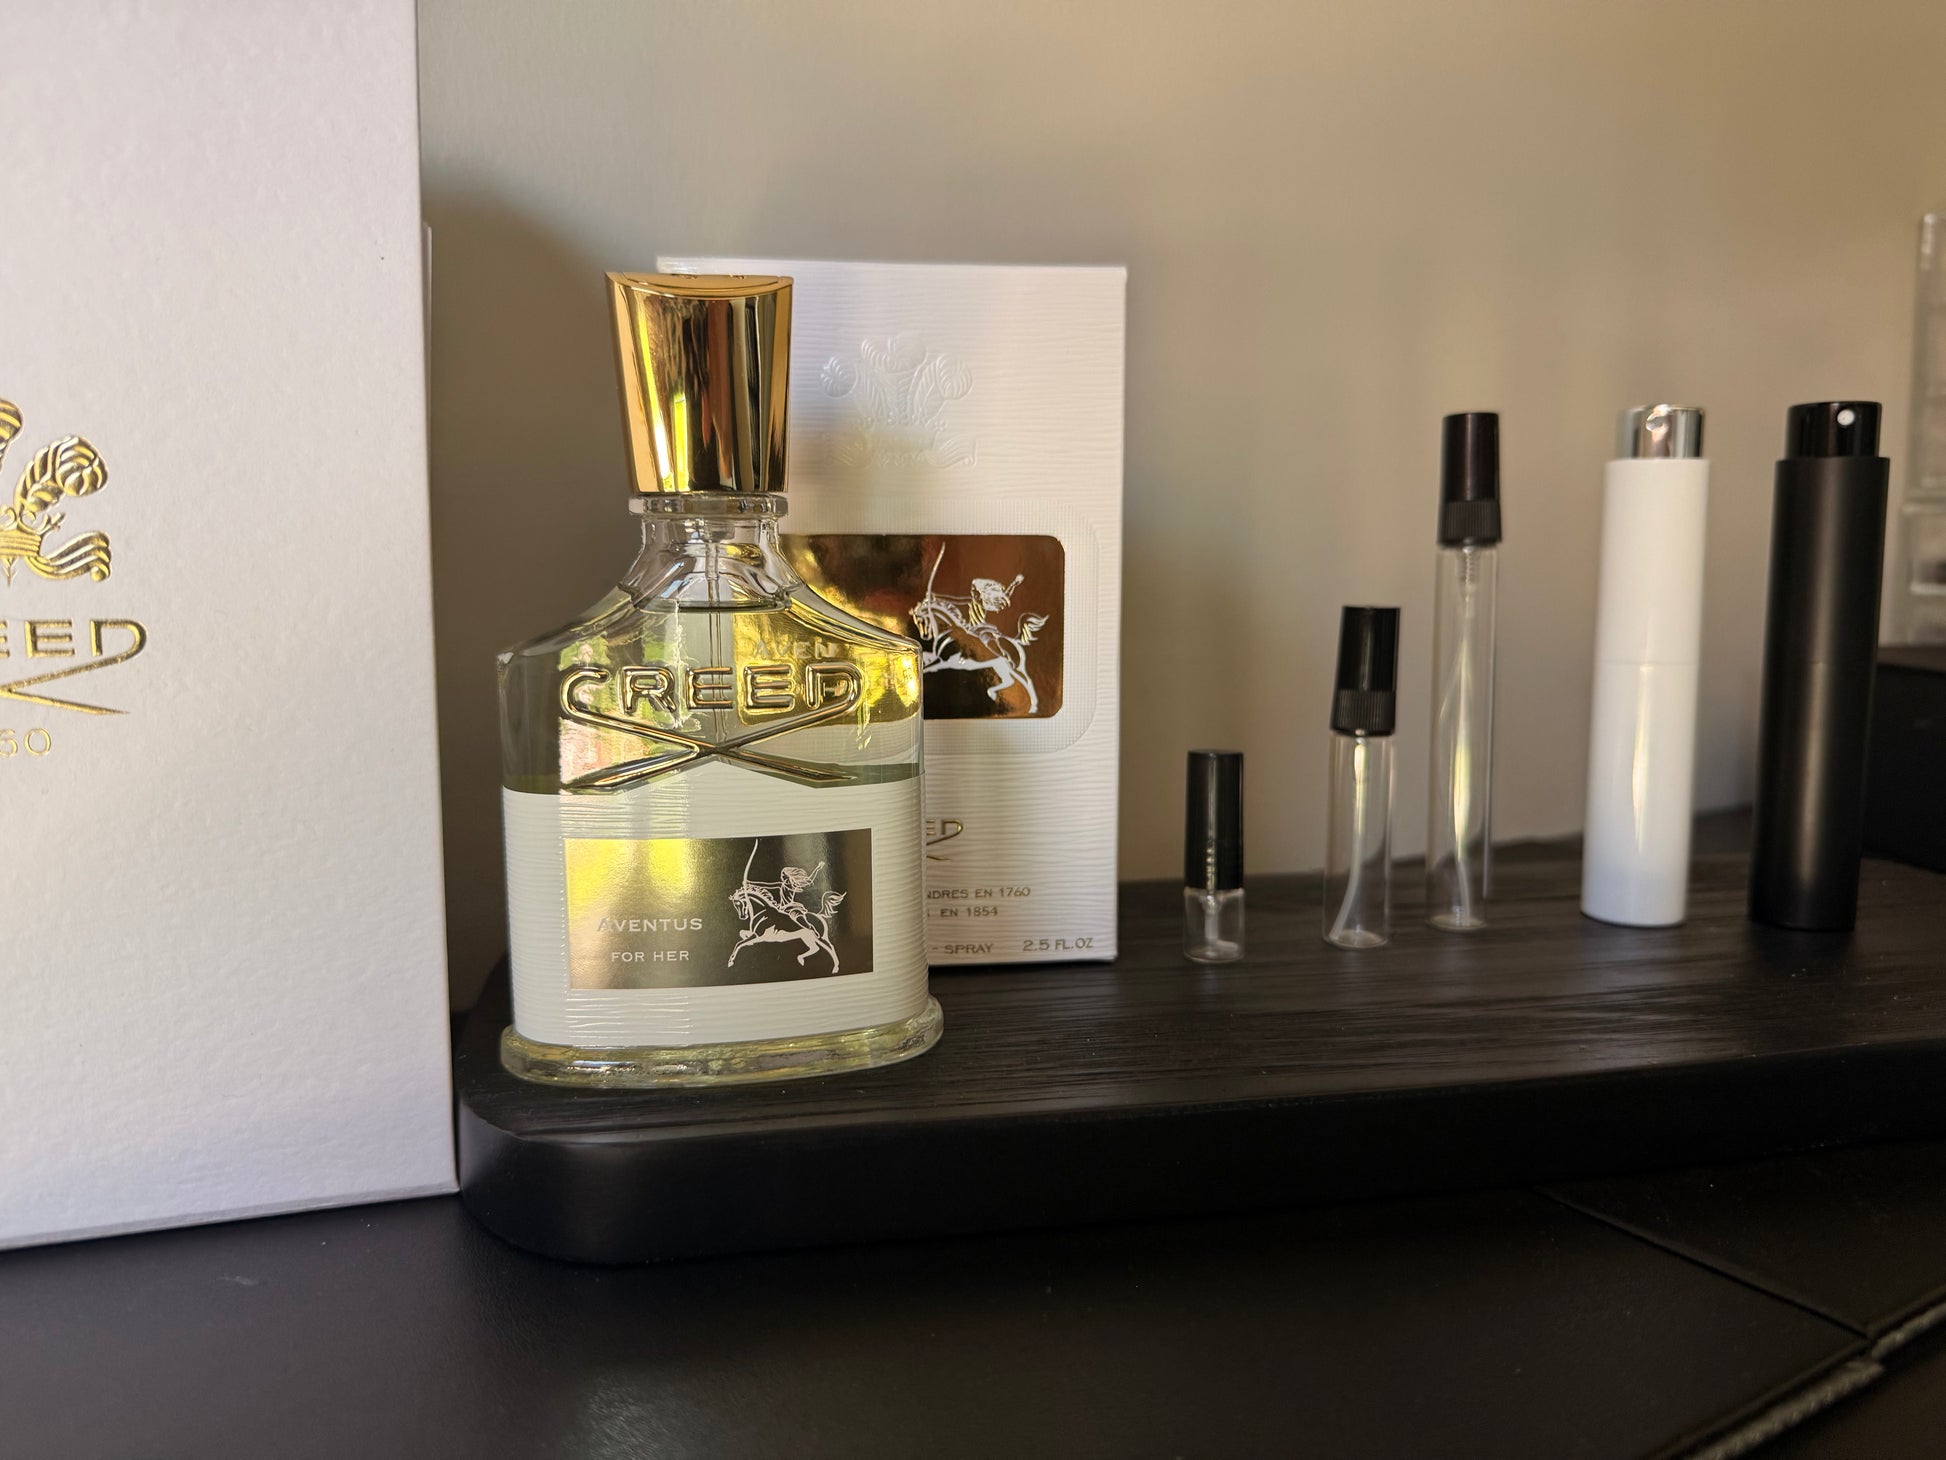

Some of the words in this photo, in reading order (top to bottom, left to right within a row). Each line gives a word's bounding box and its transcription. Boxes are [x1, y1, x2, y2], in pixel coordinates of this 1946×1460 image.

[561, 665, 862, 752] CREED
[975, 888, 993, 898] EN
[1000, 887, 1031, 897] 1760
[940, 908, 958, 917] EN
[967, 906, 998, 917] 1854
[597, 917, 703, 933] AVENTUS
[944, 943, 993, 954] SPRAY
[1023, 939, 1049, 952] 2.5
[611, 951, 645, 962] FOR
[653, 950, 690, 961] HER
